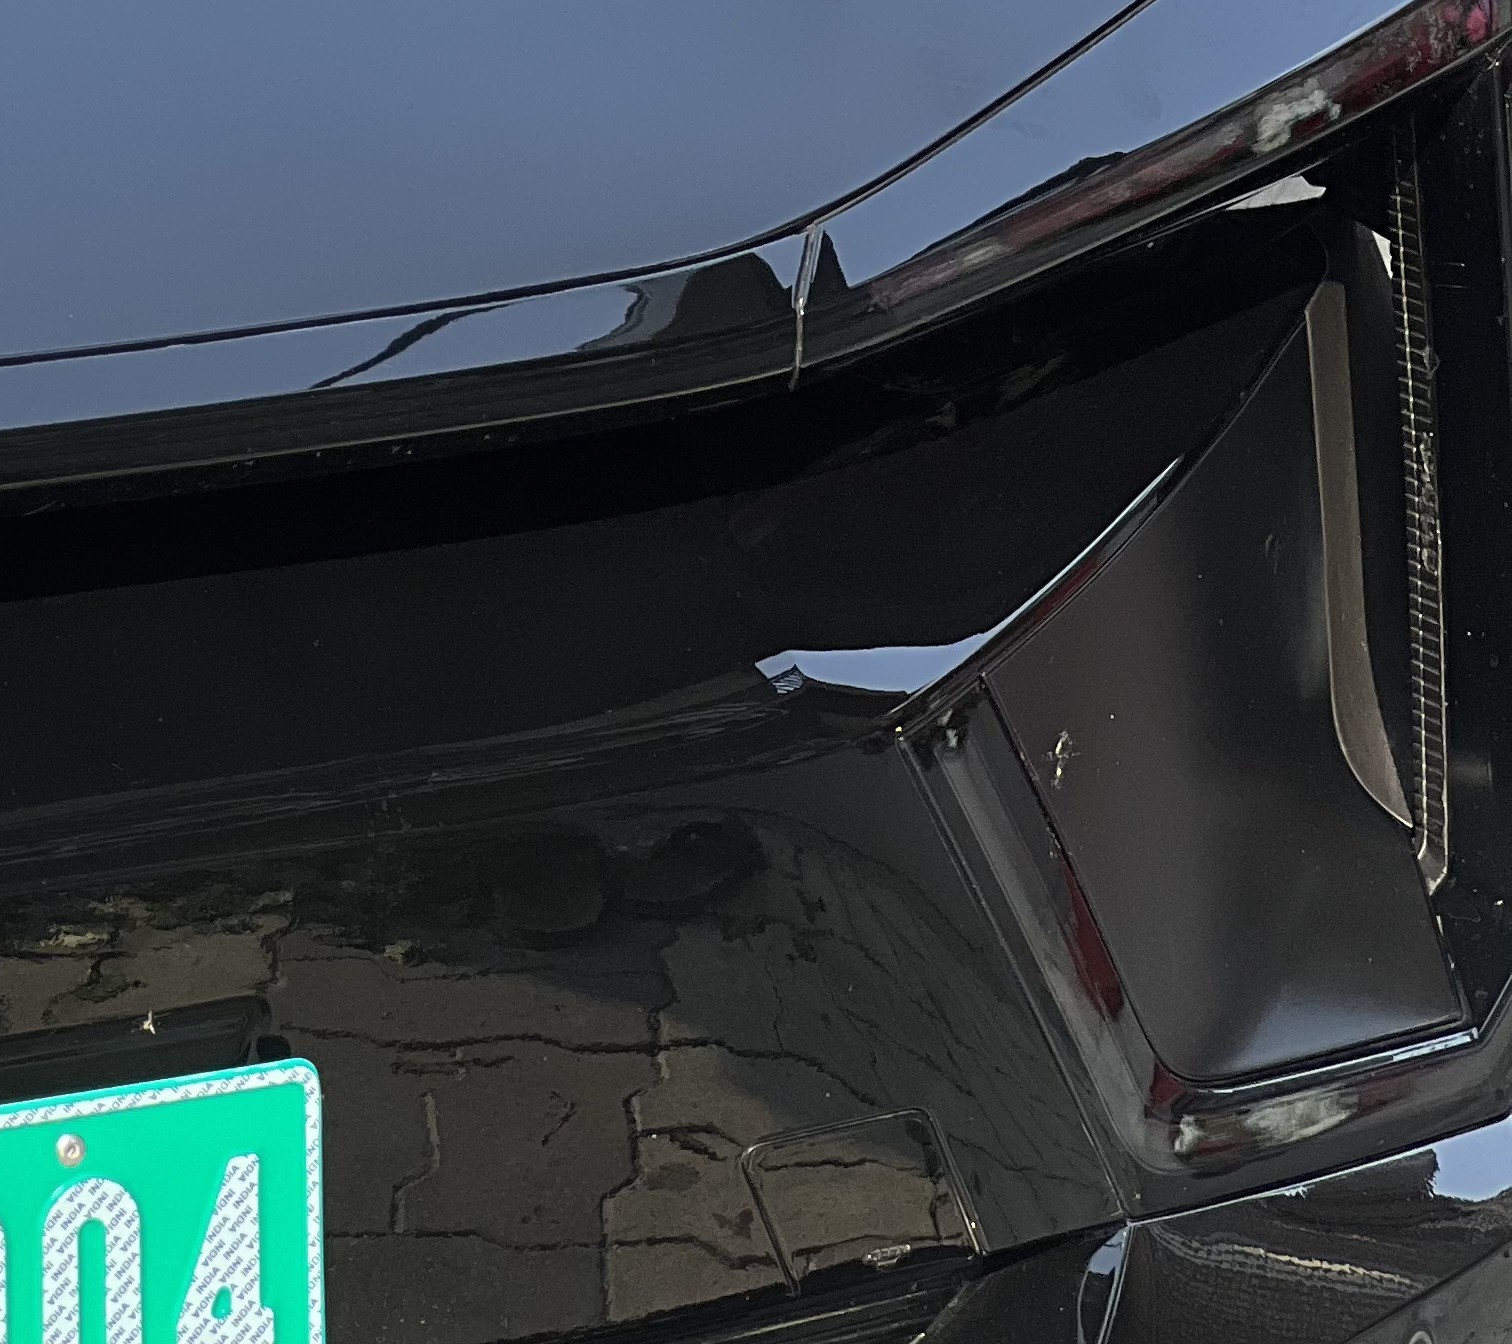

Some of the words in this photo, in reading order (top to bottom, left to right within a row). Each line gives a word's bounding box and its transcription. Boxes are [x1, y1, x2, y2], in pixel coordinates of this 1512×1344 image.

[233, 1181, 257, 1209] INDIA
[60, 1203, 85, 1230] INDIA
[206, 1216, 230, 1244] INDIA
[228, 1205, 253, 1233] INDIA
[201, 1238, 226, 1267] INDIA
[223, 1232, 248, 1260] INDIA
[51, 1253, 76, 1282] INDIA
[114, 1252, 139, 1280] INDIA
[196, 1266, 221, 1294] INDIA
[218, 1256, 243, 1283] INDIA
[47, 1277, 72, 1305] INDIA
[110, 1275, 135, 1303] INDIA
[231, 1299, 256, 1327] INDIA
[249, 1316, 273, 1343] INDIA
